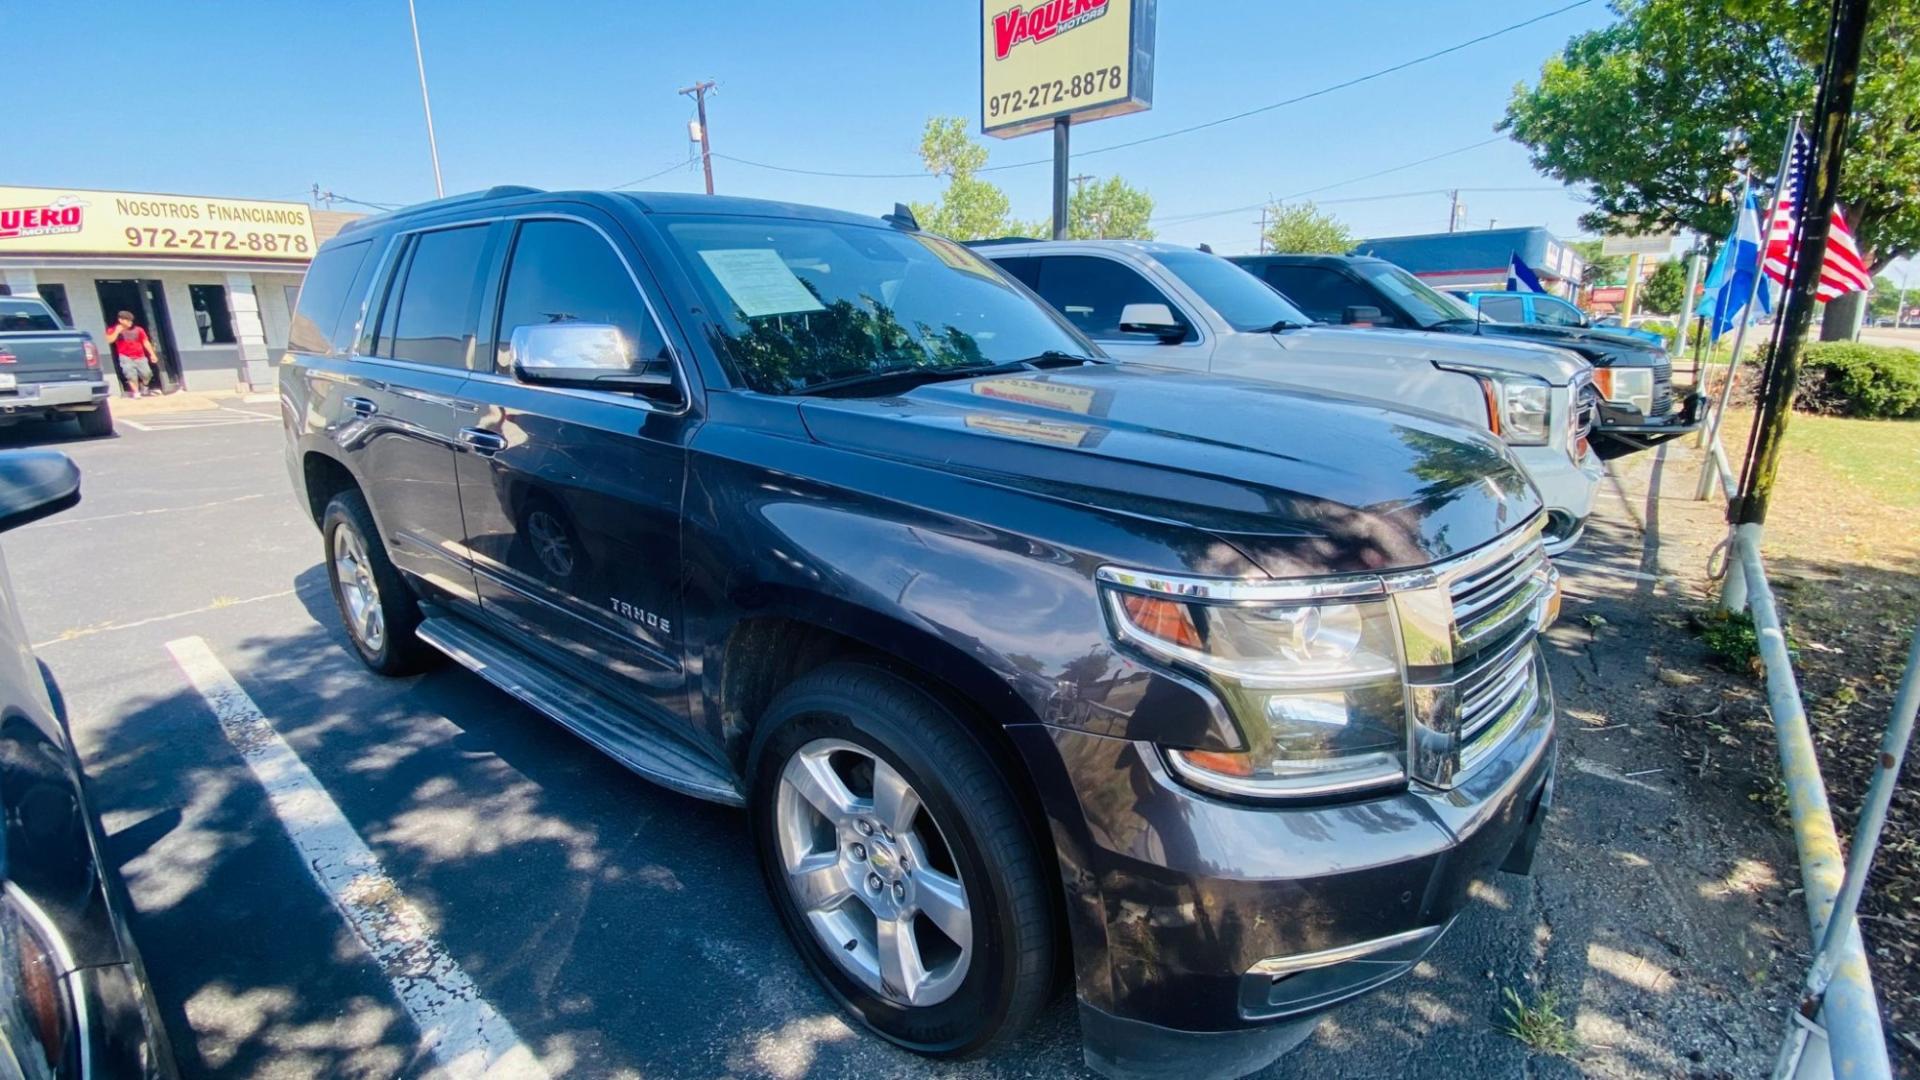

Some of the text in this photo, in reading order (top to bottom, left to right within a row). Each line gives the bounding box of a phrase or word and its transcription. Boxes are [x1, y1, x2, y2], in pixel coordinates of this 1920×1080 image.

[1058, 6, 1105, 33] MOTORS
[990, 65, 1121, 117] 972-272-8878
[0, 207, 80, 236] UERO
[116, 198, 305, 226] NOSOTROS FINANCIAMOS
[125, 226, 308, 253] 972-272-8878
[609, 597, 671, 634] TAHOE
